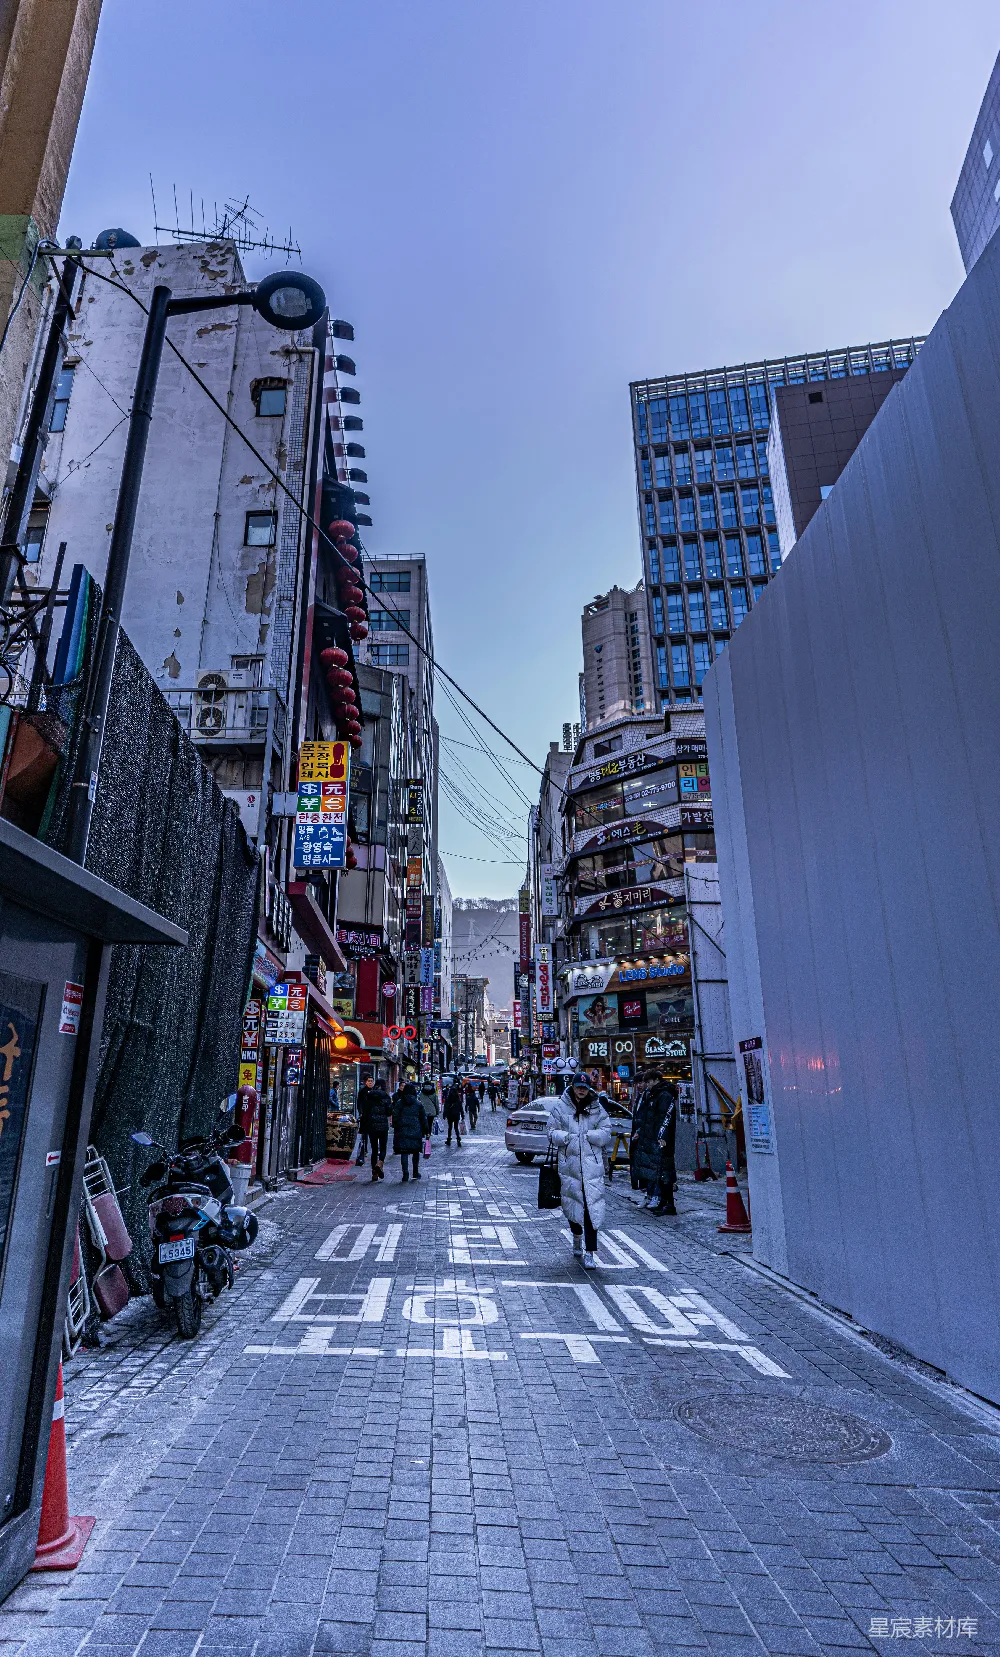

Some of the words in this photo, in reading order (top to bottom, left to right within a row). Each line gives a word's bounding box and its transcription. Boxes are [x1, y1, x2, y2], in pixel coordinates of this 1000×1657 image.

[596, 658, 606, 720] PLATINUM
[324, 783, 344, 795] 元
[298, 812, 343, 824] 한중환전
[298, 825, 315, 835] 명품
[618, 964, 648, 984] LENS
[648, 957, 685, 980] Studio
[290, 986, 303, 997] 元
[245, 1000, 260, 1015] $
[243, 1015, 259, 1031] 元
[243, 1031, 257, 1047] ¥
[241, 1050, 257, 1061] HKD
[587, 1041, 608, 1058] 안경
[168, 1246, 191, 1259] 5345
[242, 1276, 793, 1379] 보호구역
